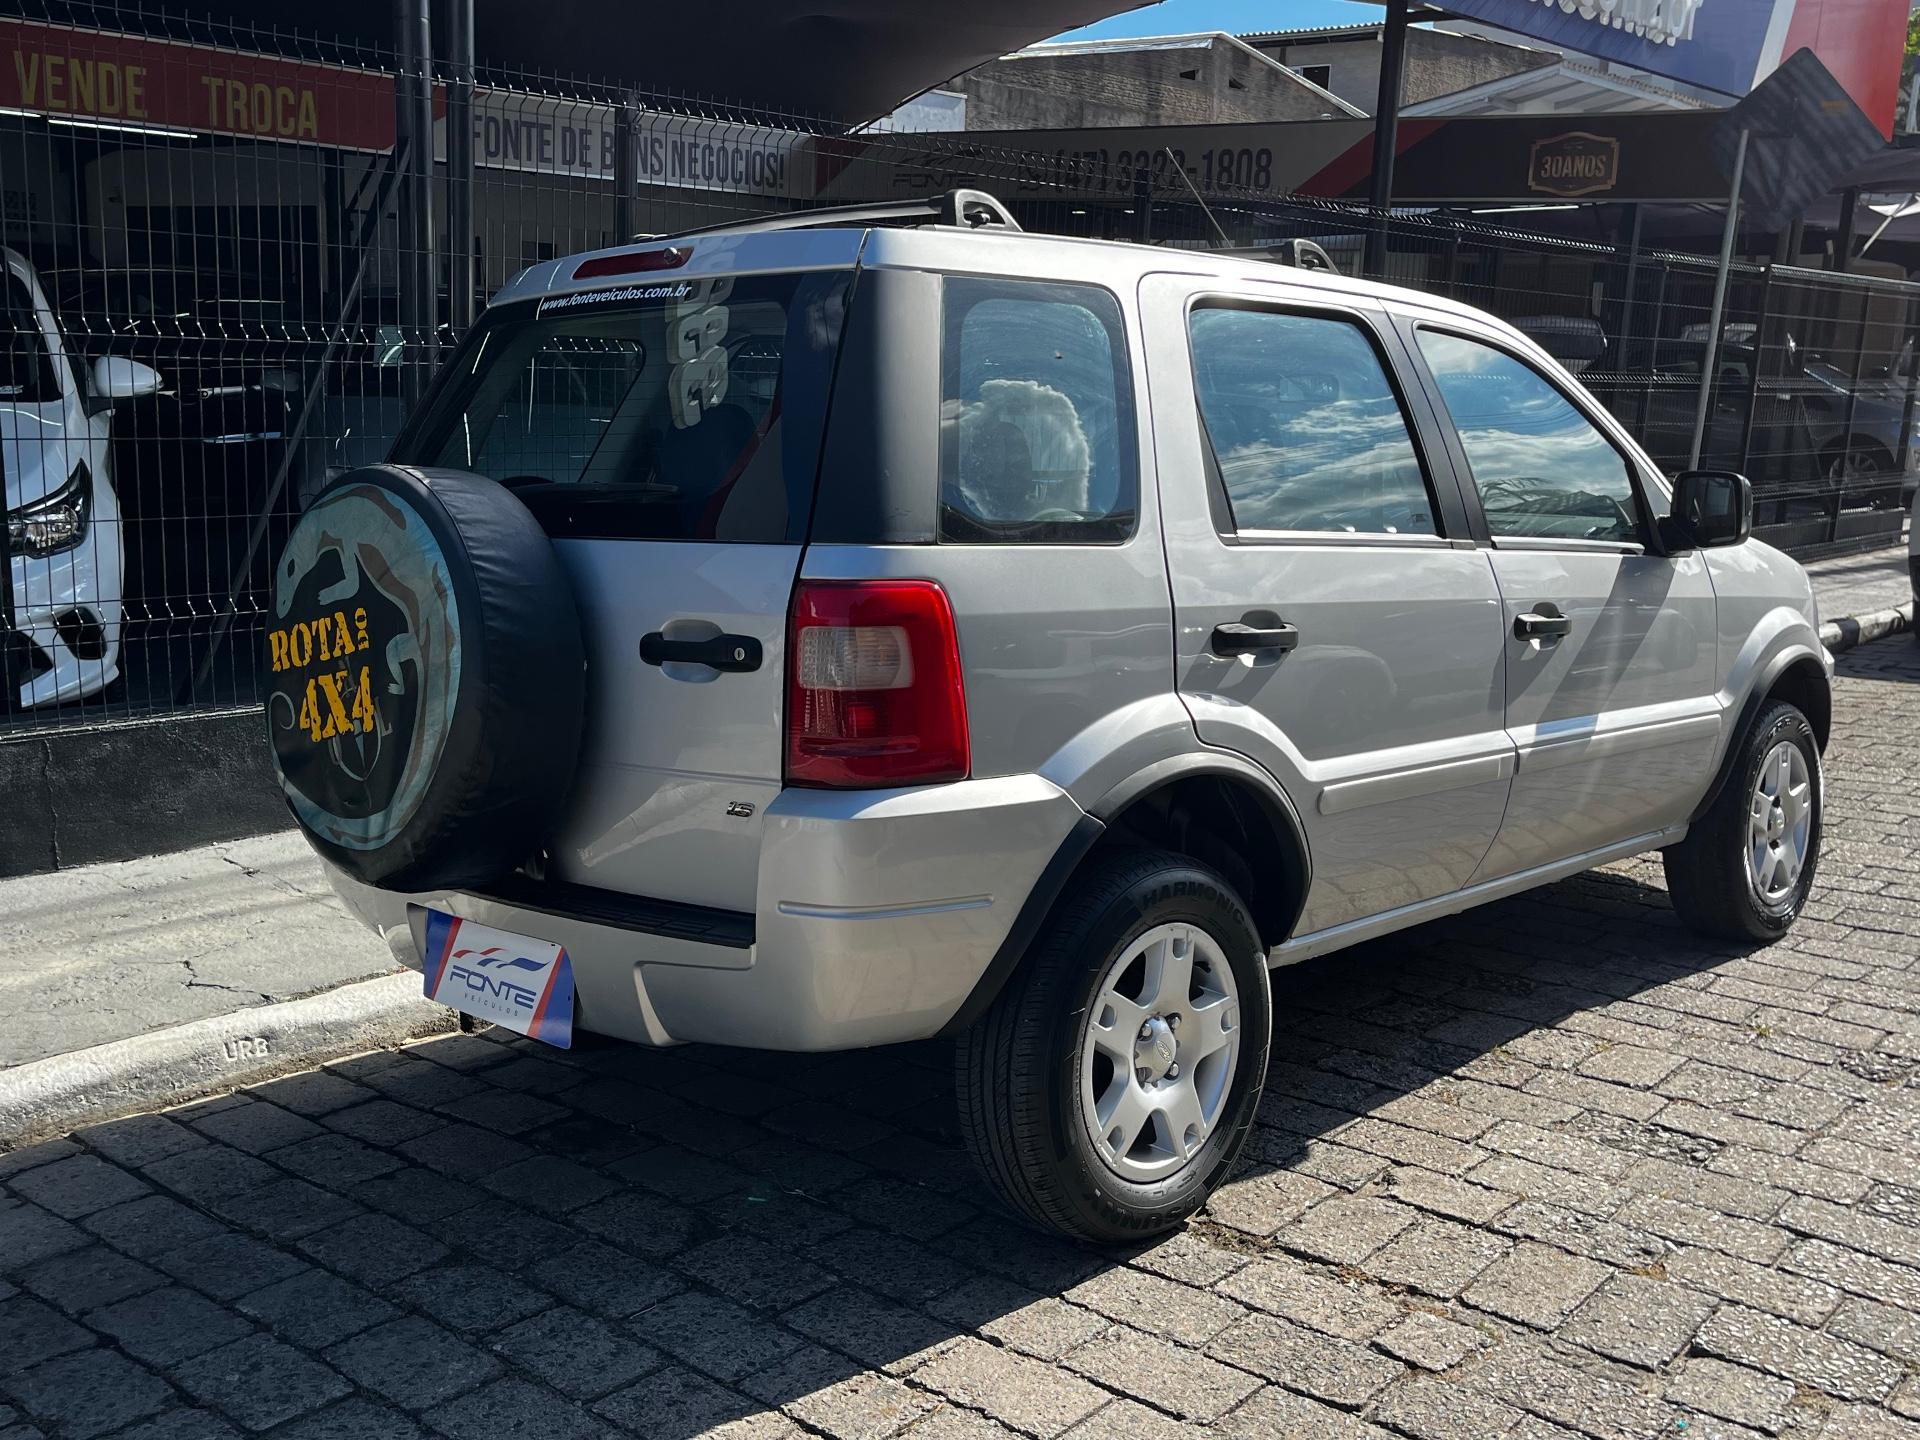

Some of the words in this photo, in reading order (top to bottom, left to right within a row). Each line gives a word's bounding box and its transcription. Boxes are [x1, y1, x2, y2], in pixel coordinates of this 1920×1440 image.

[15, 50, 148, 118] VENDE
[202, 76, 319, 138] TROCA
[474, 114, 554, 165] FONTE
[562, 126, 593, 169] DE
[601, 133, 665, 178] BNS
[671, 140, 784, 190] NEGOCIOS!
[540, 283, 692, 311] www.fonteveiculos.com.br
[268, 611, 356, 672] ROTA
[299, 666, 375, 742] 4X4
[450, 965, 537, 1010] FONTE
